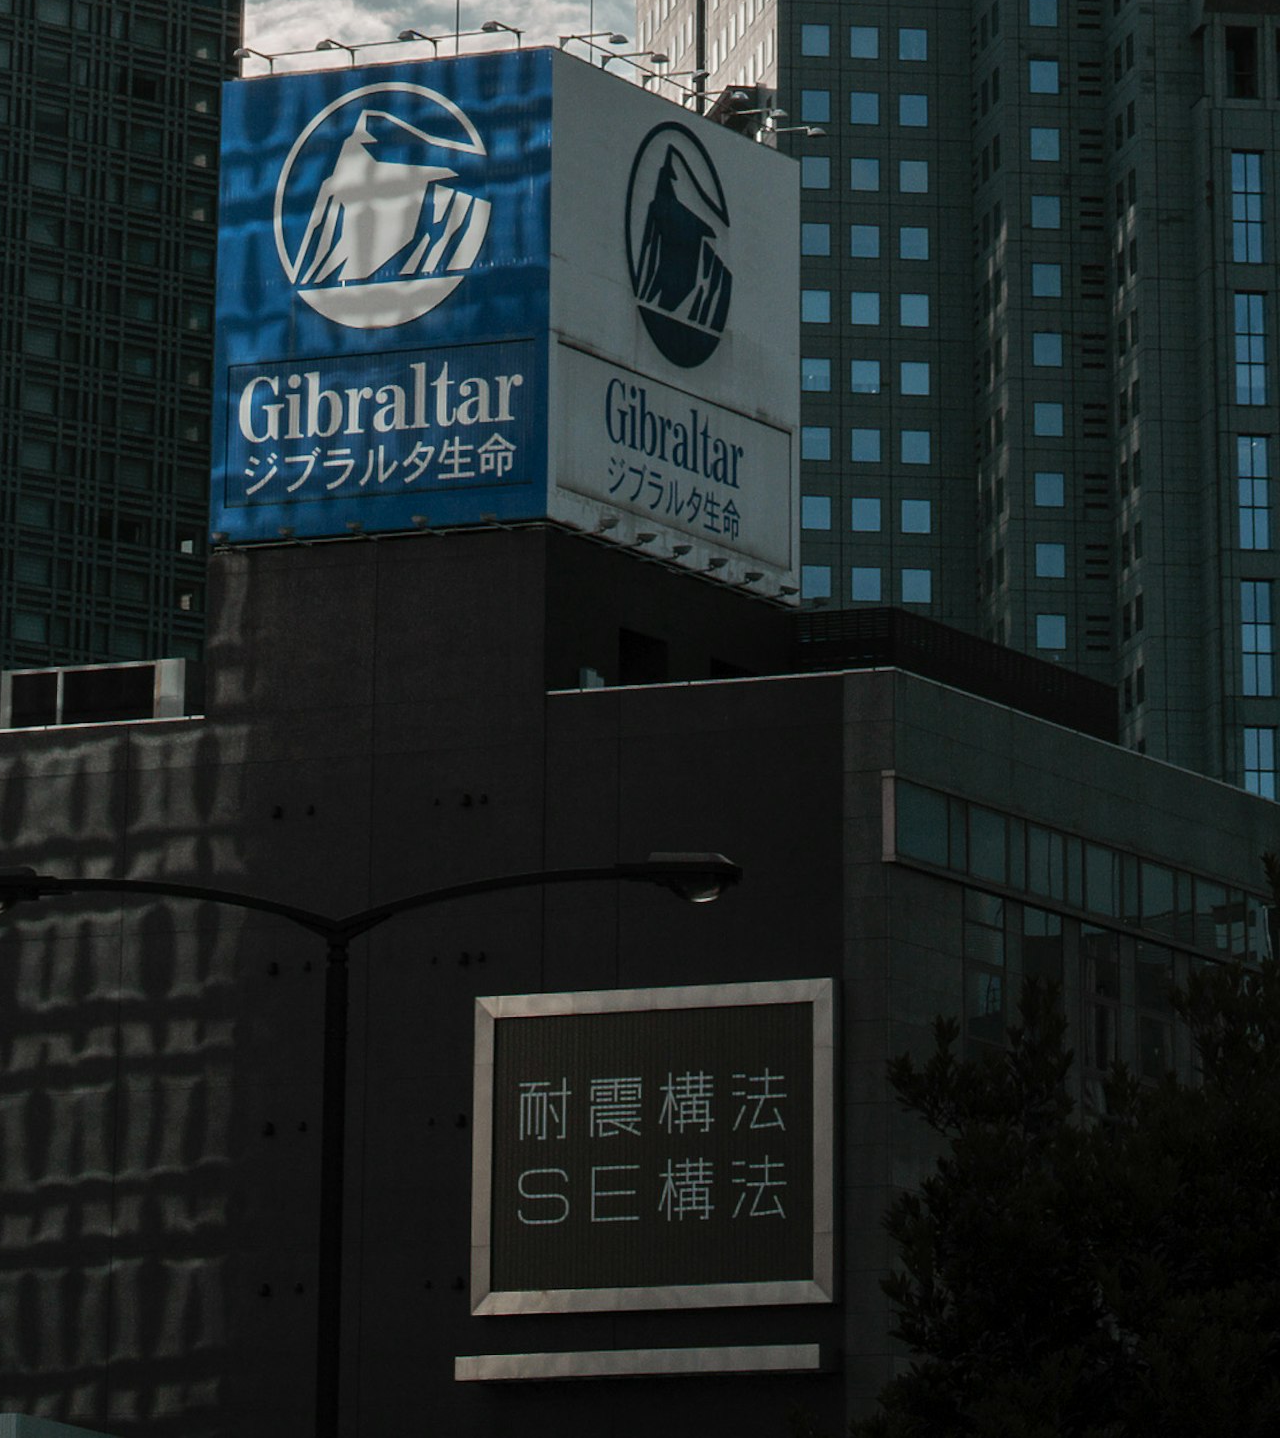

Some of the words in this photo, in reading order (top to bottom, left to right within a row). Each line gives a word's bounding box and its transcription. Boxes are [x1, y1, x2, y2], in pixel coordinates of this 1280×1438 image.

[238, 362, 524, 444] Gibraltar
[605, 378, 744, 490] Gibraltar
[244, 432, 517, 496] ジブラルタ生命
[608, 457, 741, 541] ジブラルタ生命
[518, 1067, 789, 1141] 耐震構法
[518, 1154, 789, 1225] SE構法
